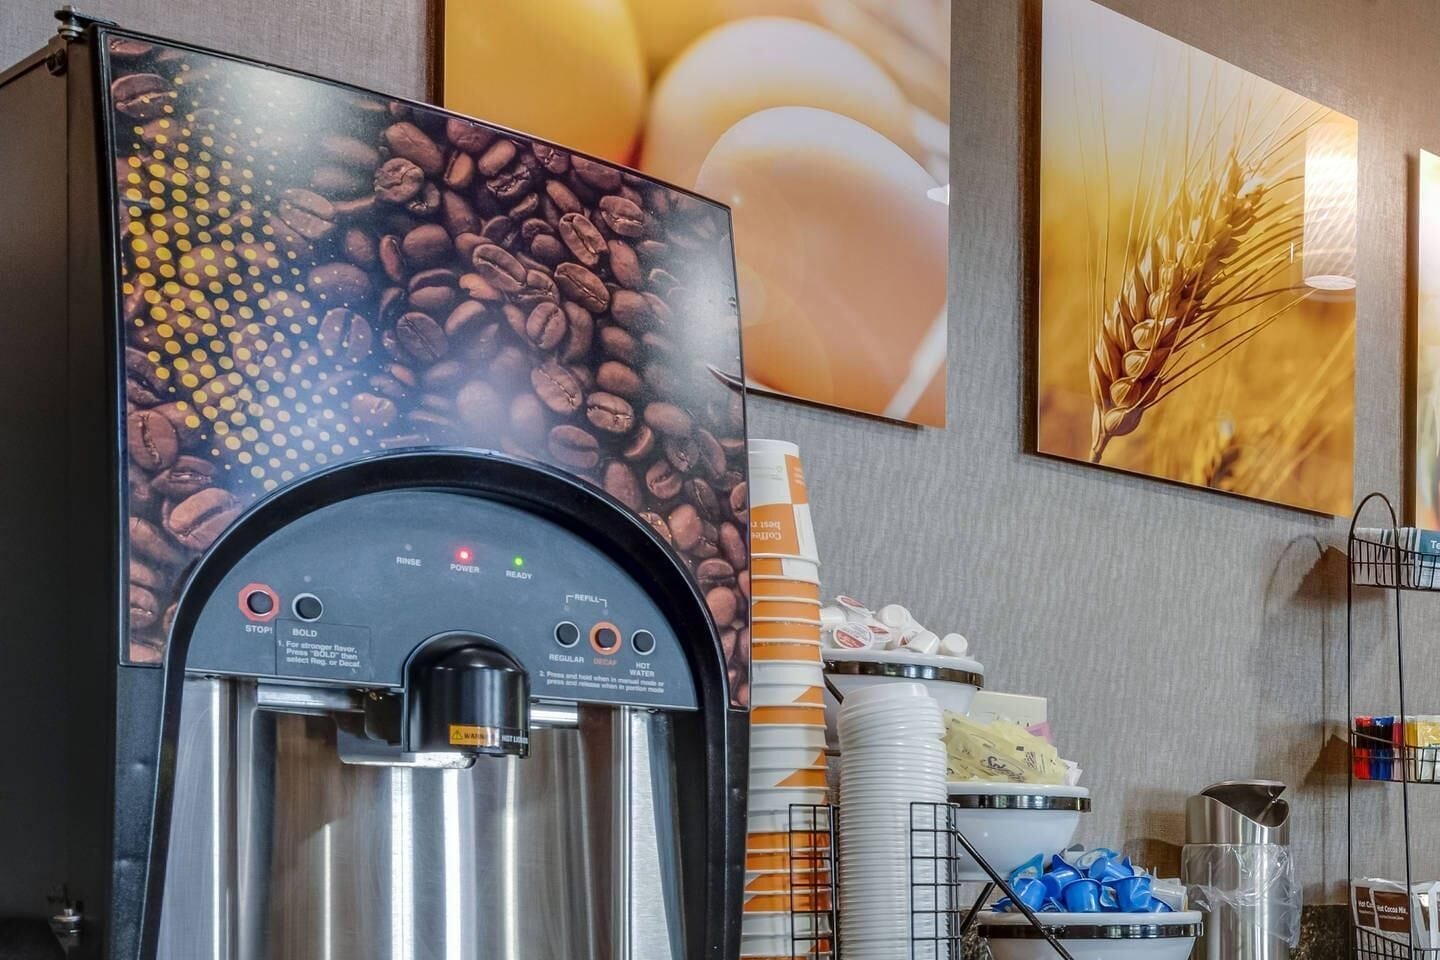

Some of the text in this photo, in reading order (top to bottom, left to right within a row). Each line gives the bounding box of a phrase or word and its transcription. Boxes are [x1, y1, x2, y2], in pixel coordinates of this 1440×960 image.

[396, 556, 422, 567] RINSE
[450, 563, 480, 574] POWER
[505, 569, 533, 580] READY
[574, 593, 600, 603] REFILL
[245, 624, 273, 634] STOP!
[292, 628, 317, 638] BOLD
[286, 640, 300, 648] For
[301, 642, 332, 651] stronger
[286, 648, 308, 657] Press
[341, 651, 358, 660] then
[548, 653, 584, 663] REGULAR
[286, 656, 309, 664] select
[635, 662, 651, 670] HOT
[629, 669, 655, 678] WATER
[1384, 905, 1398, 913] Cocoa
